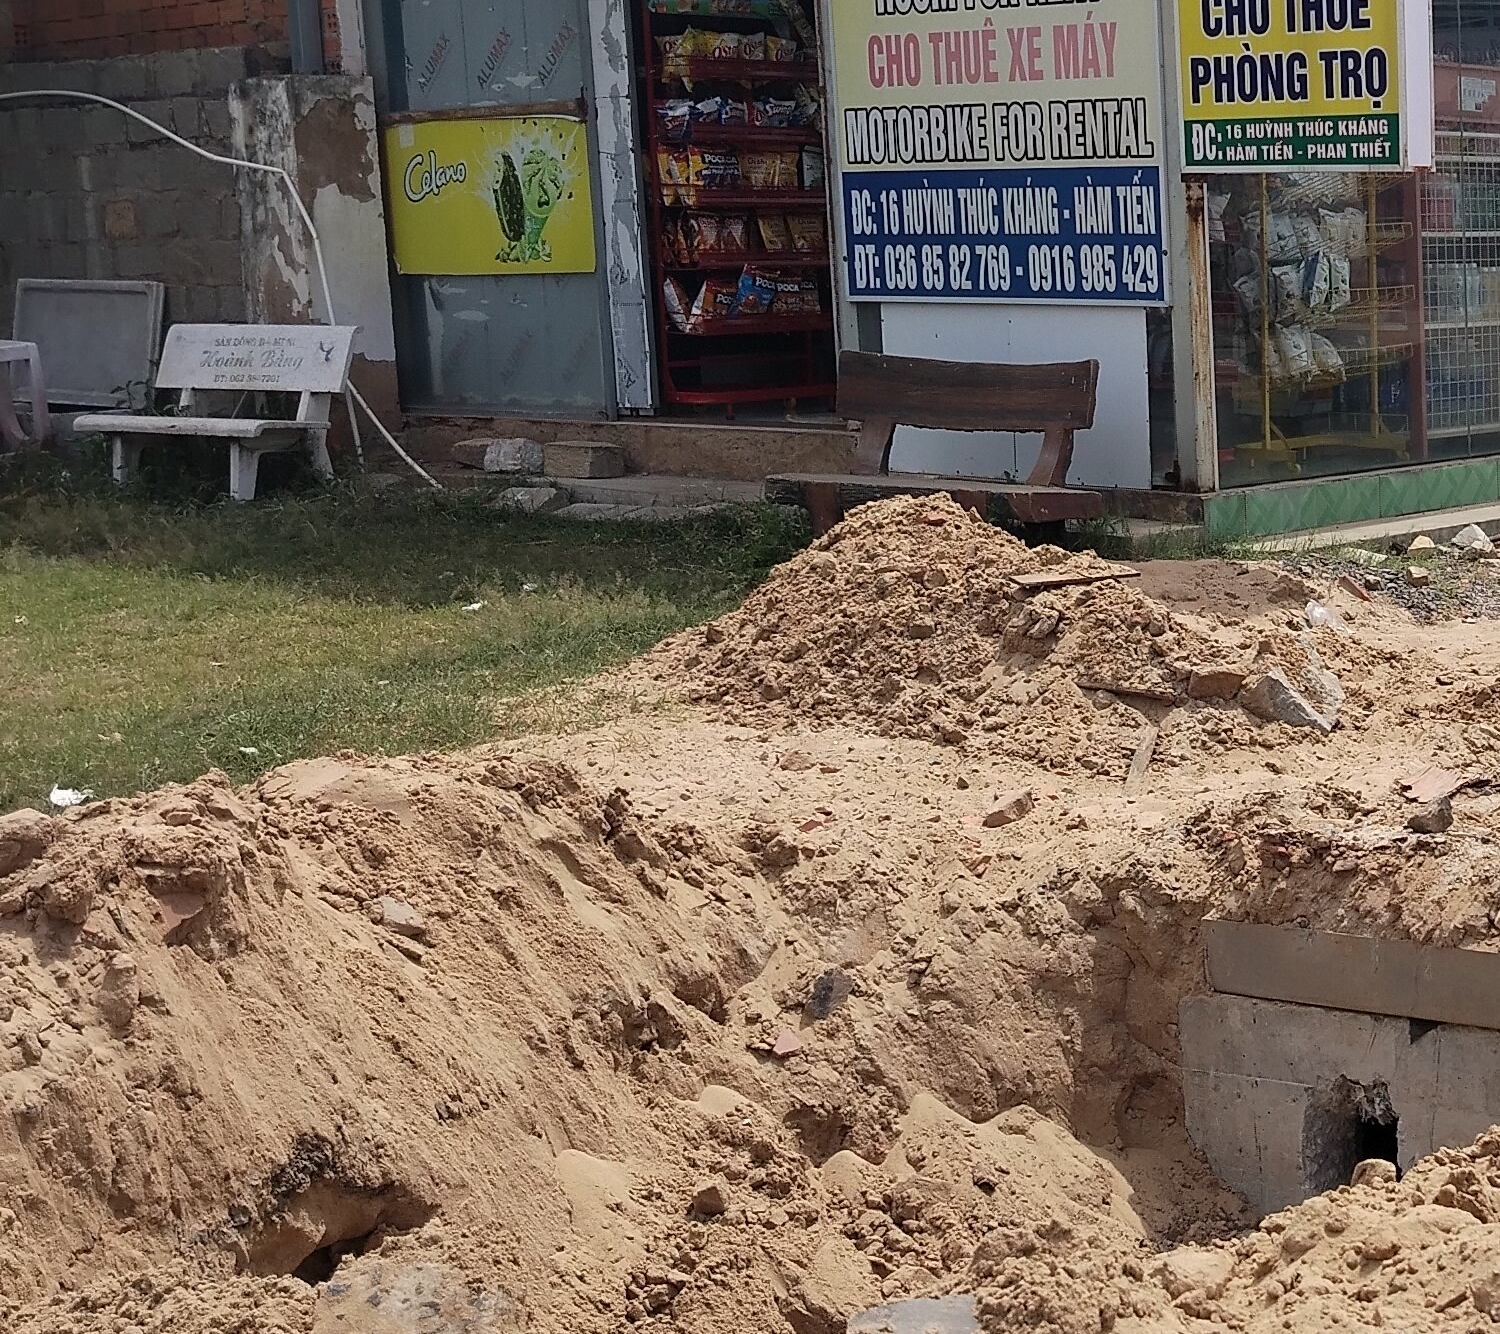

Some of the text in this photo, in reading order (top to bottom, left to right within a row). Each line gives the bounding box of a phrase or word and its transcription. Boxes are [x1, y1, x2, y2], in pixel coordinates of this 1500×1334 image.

[867, 11, 1118, 90] CHO THUÊ XE MÁY
[1189, 42, 1308, 106] PHÒNG
[1319, 46, 1389, 109] TRỌ
[844, 98, 1154, 165] MOTORBIKE FOR RENTAL
[1191, 117, 1389, 162] ĐC: 16 HUỲNH THÚC KHÁNG
[1225, 142, 1258, 162] HÀM
[1261, 138, 1294, 161] TIẾN
[1307, 142, 1347, 159] PHAN
[1350, 136, 1392, 159] THIẾT
[404, 150, 467, 203] Celano
[850, 188, 877, 237] ĐC:
[879, 189, 899, 236] 16
[902, 178, 955, 236] HUỲNH
[959, 176, 1000, 236] THÚC
[1003, 176, 1060, 236] KHÁNG
[1075, 176, 1114, 236] HÀM
[1118, 169, 1157, 236] TIẾN
[855, 249, 881, 292] ĐT:
[884, 247, 917, 292] 036
[921, 247, 945, 292] 85
[947, 247, 973, 291] 82
[977, 245, 1011, 292] 769
[1028, 246, 1075, 293] 0916
[1080, 246, 1117, 291] 985
[1121, 249, 1159, 293] 429
